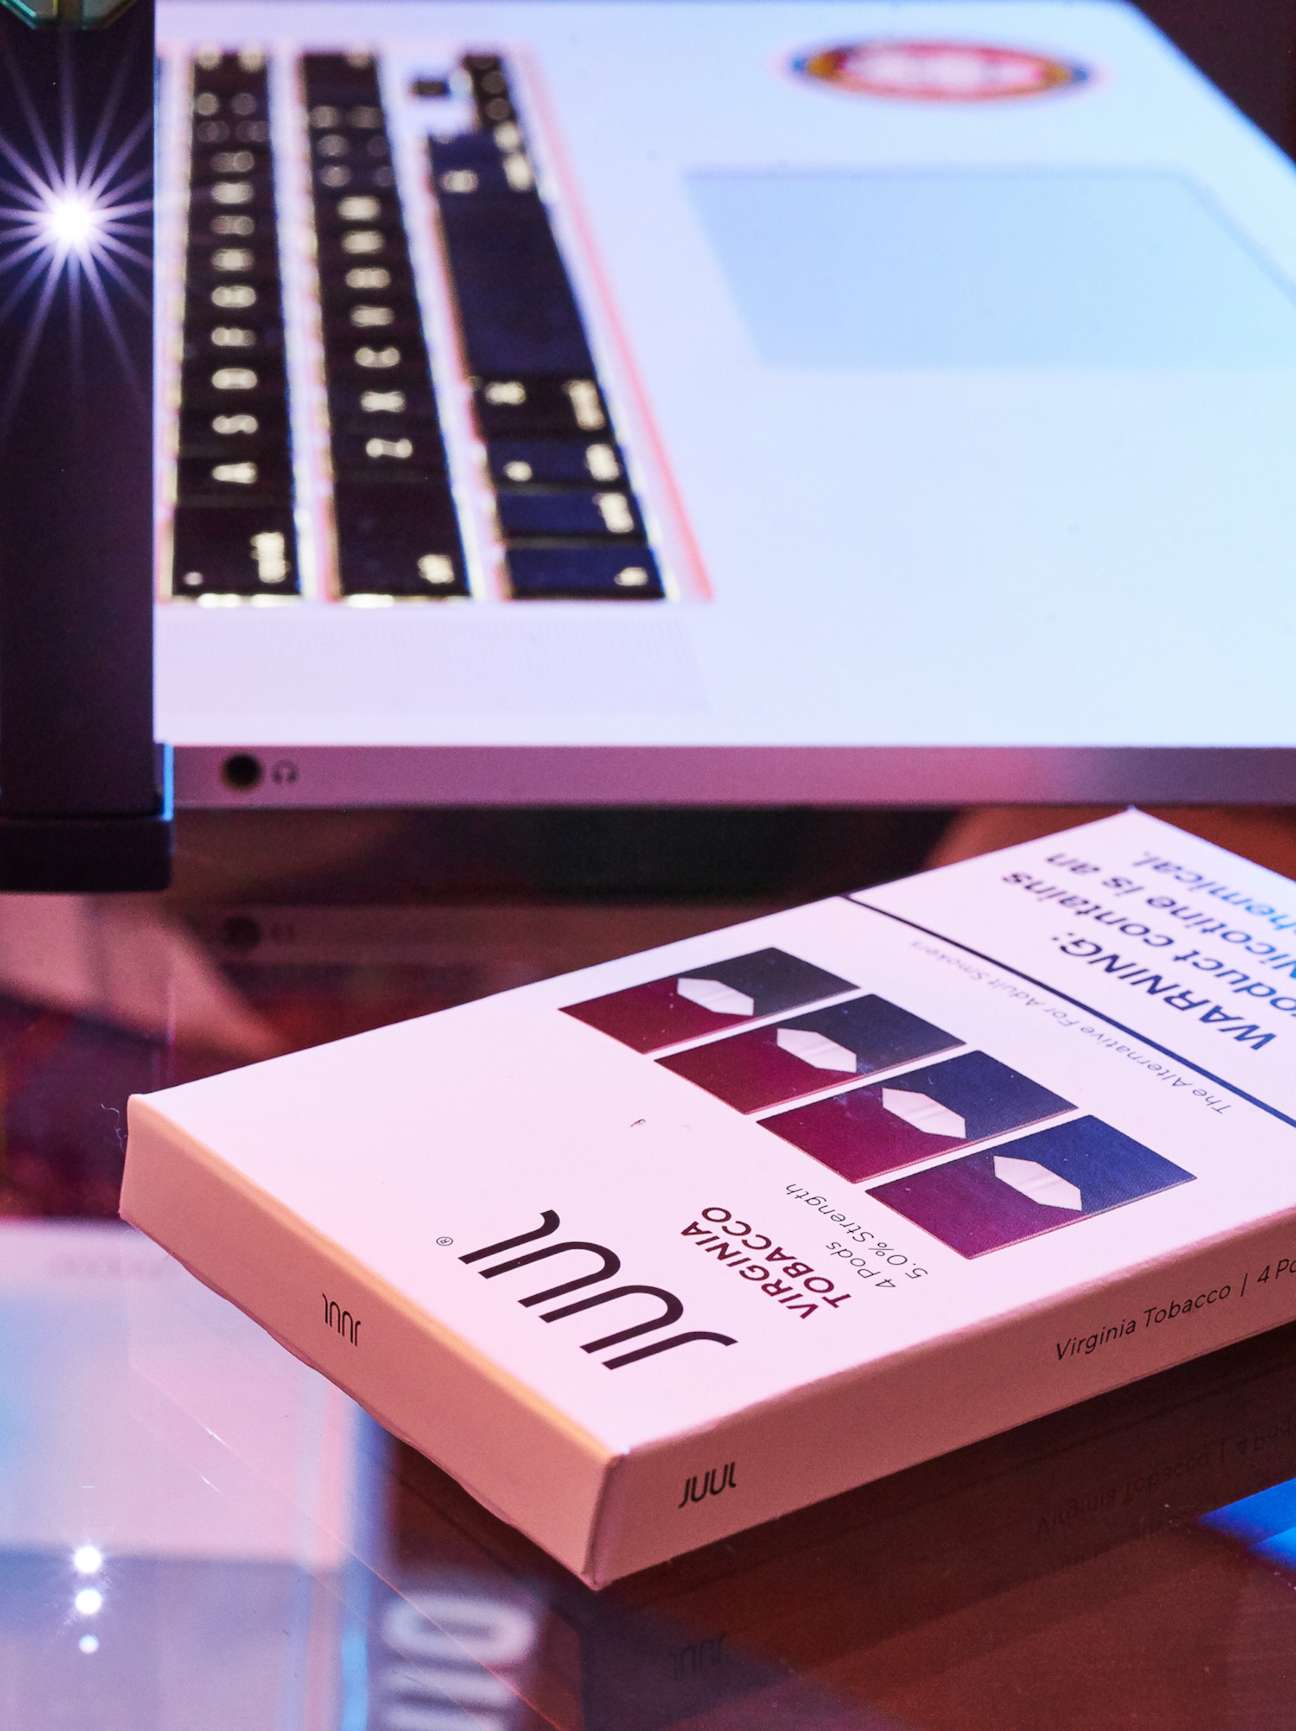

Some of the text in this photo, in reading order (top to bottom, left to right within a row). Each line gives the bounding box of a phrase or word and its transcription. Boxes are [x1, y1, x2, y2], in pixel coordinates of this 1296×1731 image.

[1045, 852, 1101, 874] an
[1101, 875, 1144, 897] is
[1132, 851, 1296, 931] hemical.
[1002, 872, 1296, 1012] oduct contains
[988, 976, 1041, 1008] Adult
[1044, 1005, 1079, 1028] For
[1052, 932, 1277, 1050] WARNING:
[1080, 1025, 1190, 1090] Alternative
[1191, 1087, 1232, 1115] The
[701, 1206, 852, 1308] TOBACCO
[785, 1183, 929, 1280] 5.0% Strength
[457, 1209, 738, 1370] JUUL
[680, 1220, 819, 1319] VIRGINIA
[825, 1241, 897, 1289] 4 Pods
[321, 1292, 362, 1347] JUUL
[1056, 1319, 1136, 1361] Virginia
[1143, 1284, 1231, 1328] Tobacco
[1257, 1265, 1271, 1284] 4
[677, 1461, 737, 1509] JUUL
